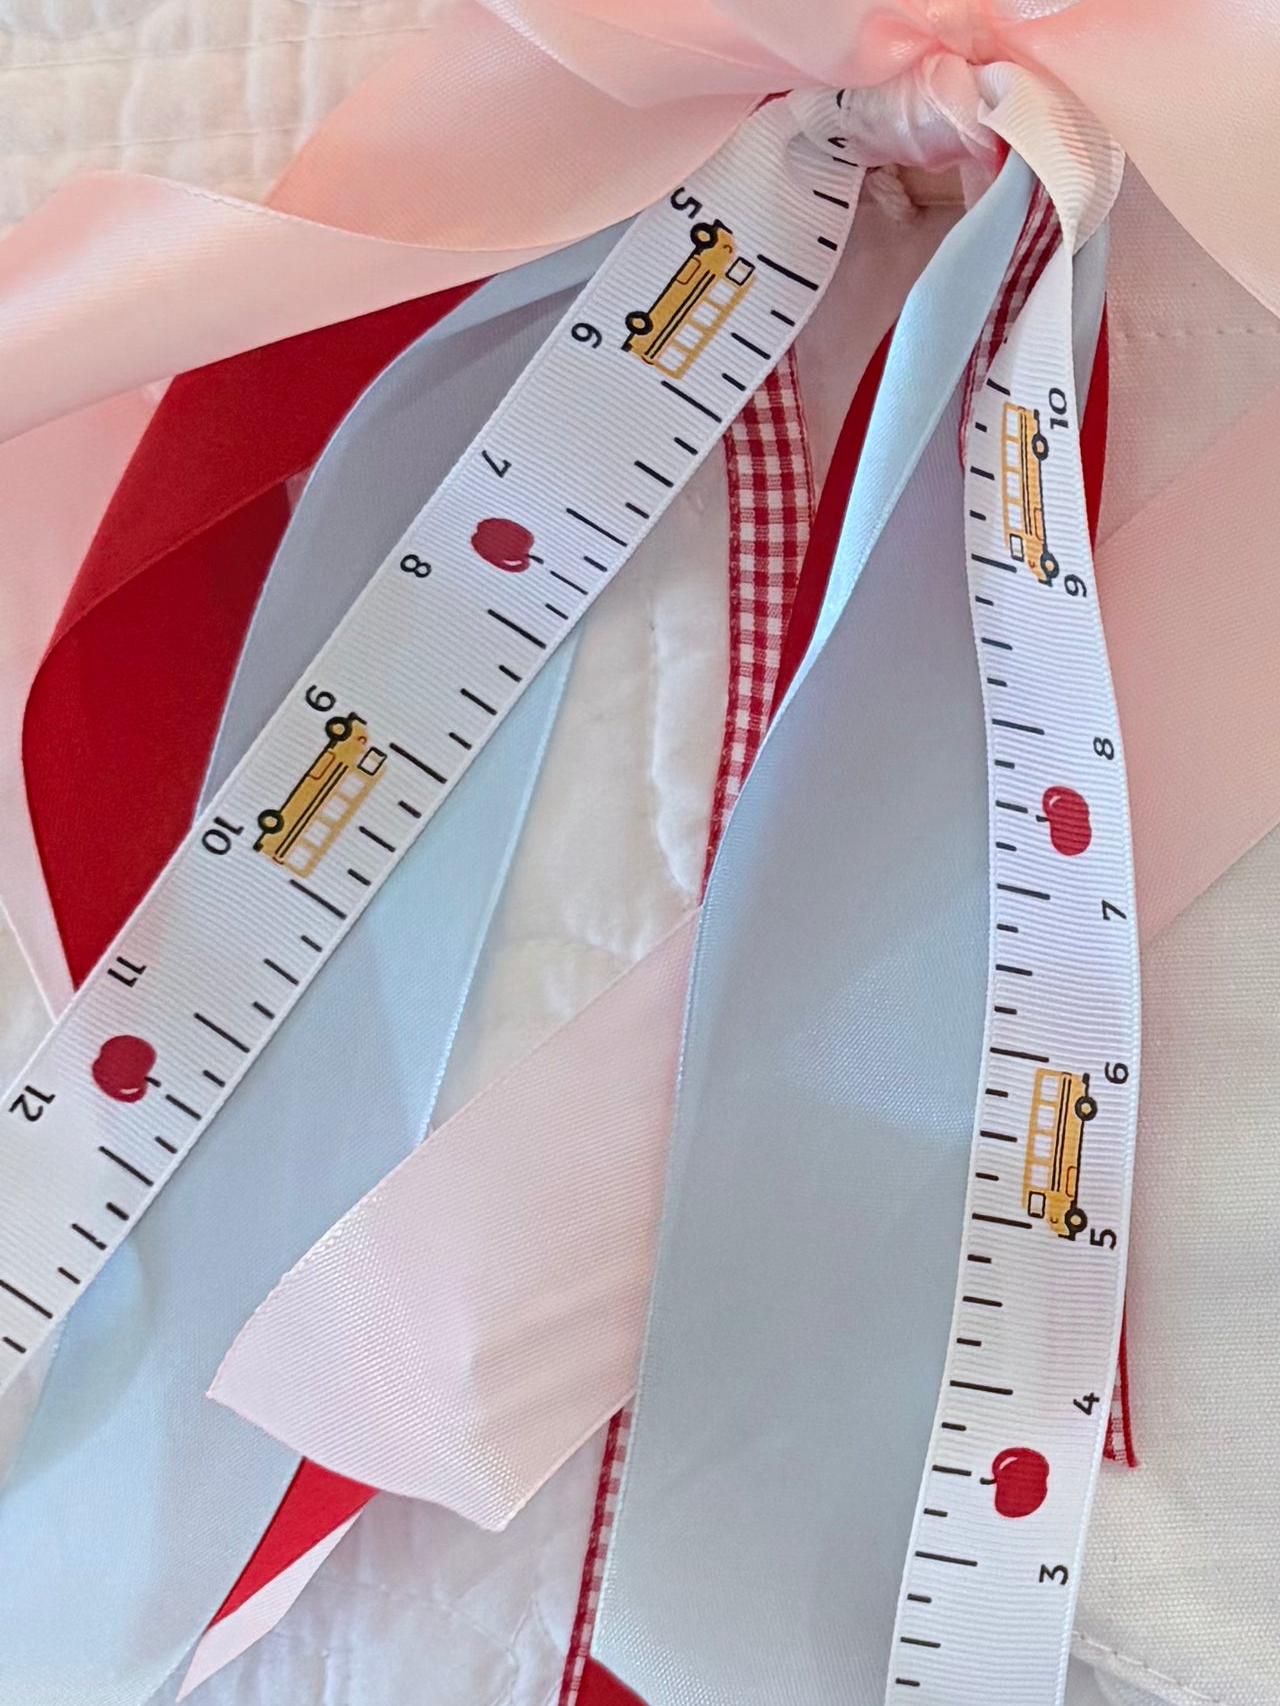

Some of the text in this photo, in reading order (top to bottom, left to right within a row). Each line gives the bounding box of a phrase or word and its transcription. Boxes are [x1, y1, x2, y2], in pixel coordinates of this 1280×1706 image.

[1048, 386, 1069, 430] 10
[1064, 573, 1087, 598] 9
[9, 186, 703, 1122] 5 6 7 8 9 10 11 12
[1092, 736, 1116, 761] 8
[1101, 898, 1127, 922] 7
[1104, 1061, 1129, 1085] 6
[1089, 1227, 1117, 1250] 5
[1072, 1391, 1101, 1417] 4
[1037, 1563, 1070, 1586] 3
